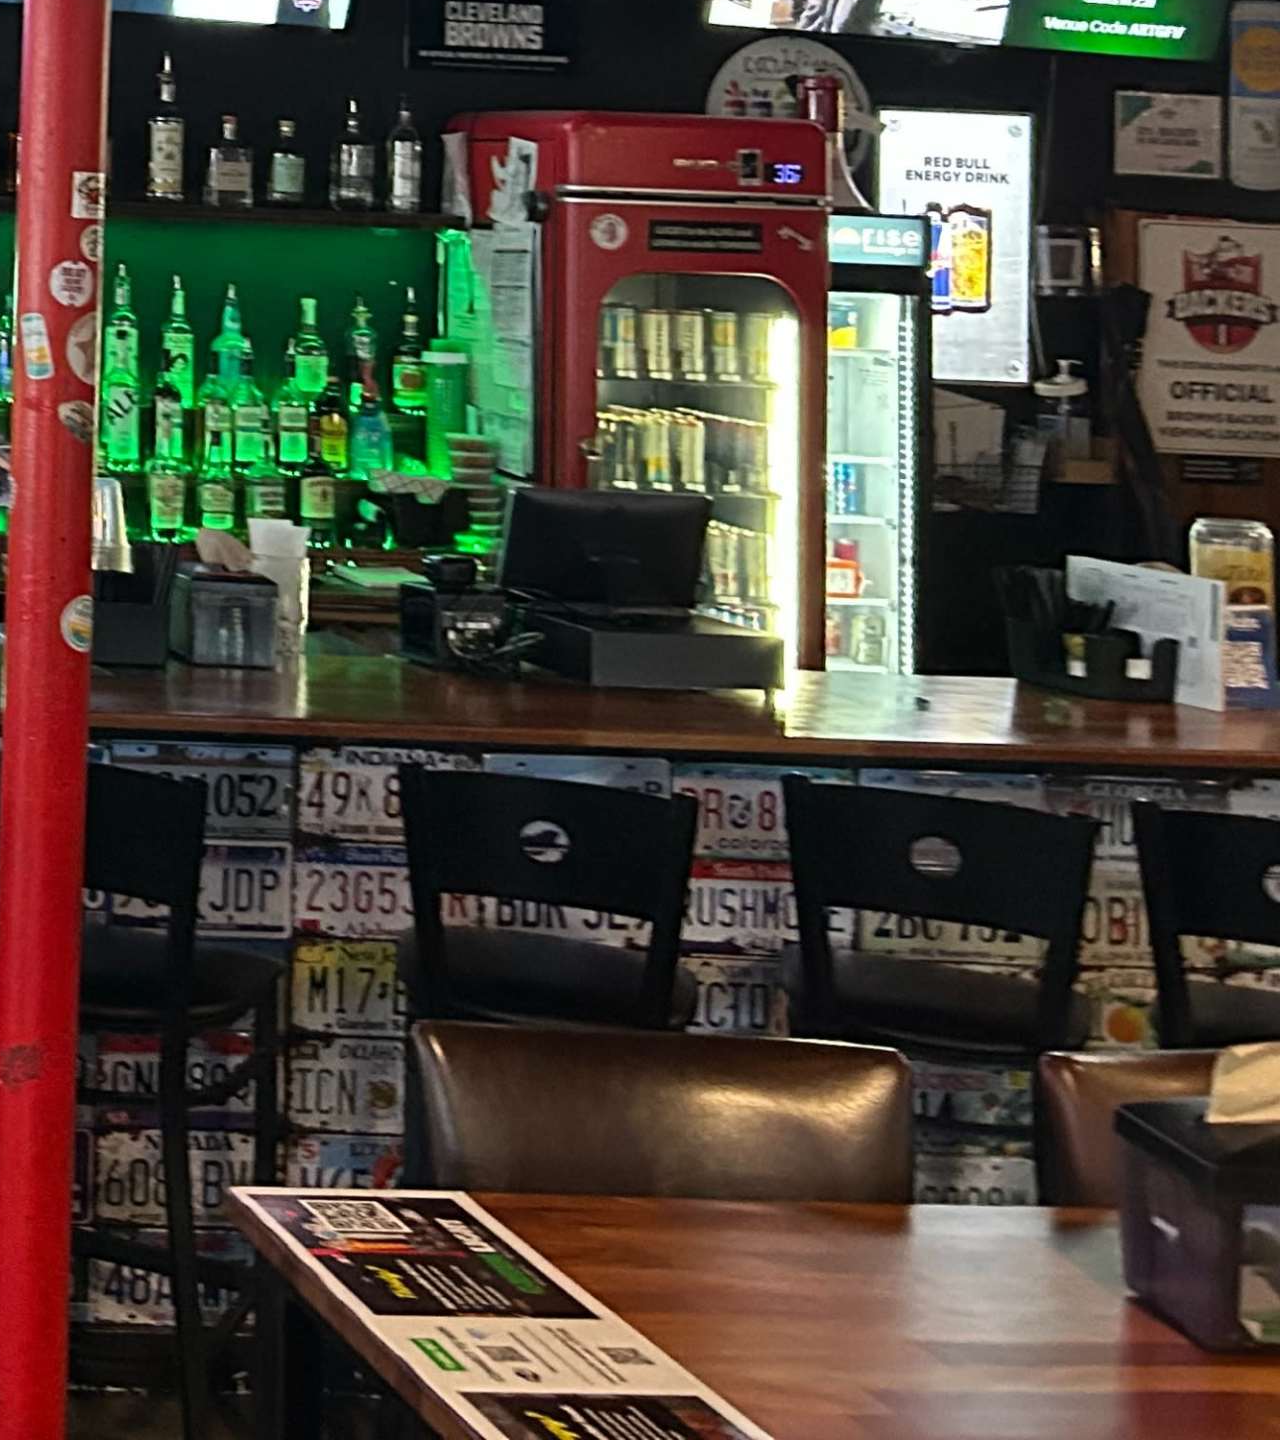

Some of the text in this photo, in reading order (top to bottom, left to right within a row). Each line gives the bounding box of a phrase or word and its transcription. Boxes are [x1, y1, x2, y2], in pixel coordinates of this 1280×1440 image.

[444, 1, 544, 25] CLEVELAND
[444, 21, 544, 50] BROWNS
[1043, 16, 1127, 35] Venue Code
[924, 156, 991, 169] RED BULL
[905, 169, 1010, 184] ENERGY DRINK
[1169, 380, 1275, 404] OFFICIAL
